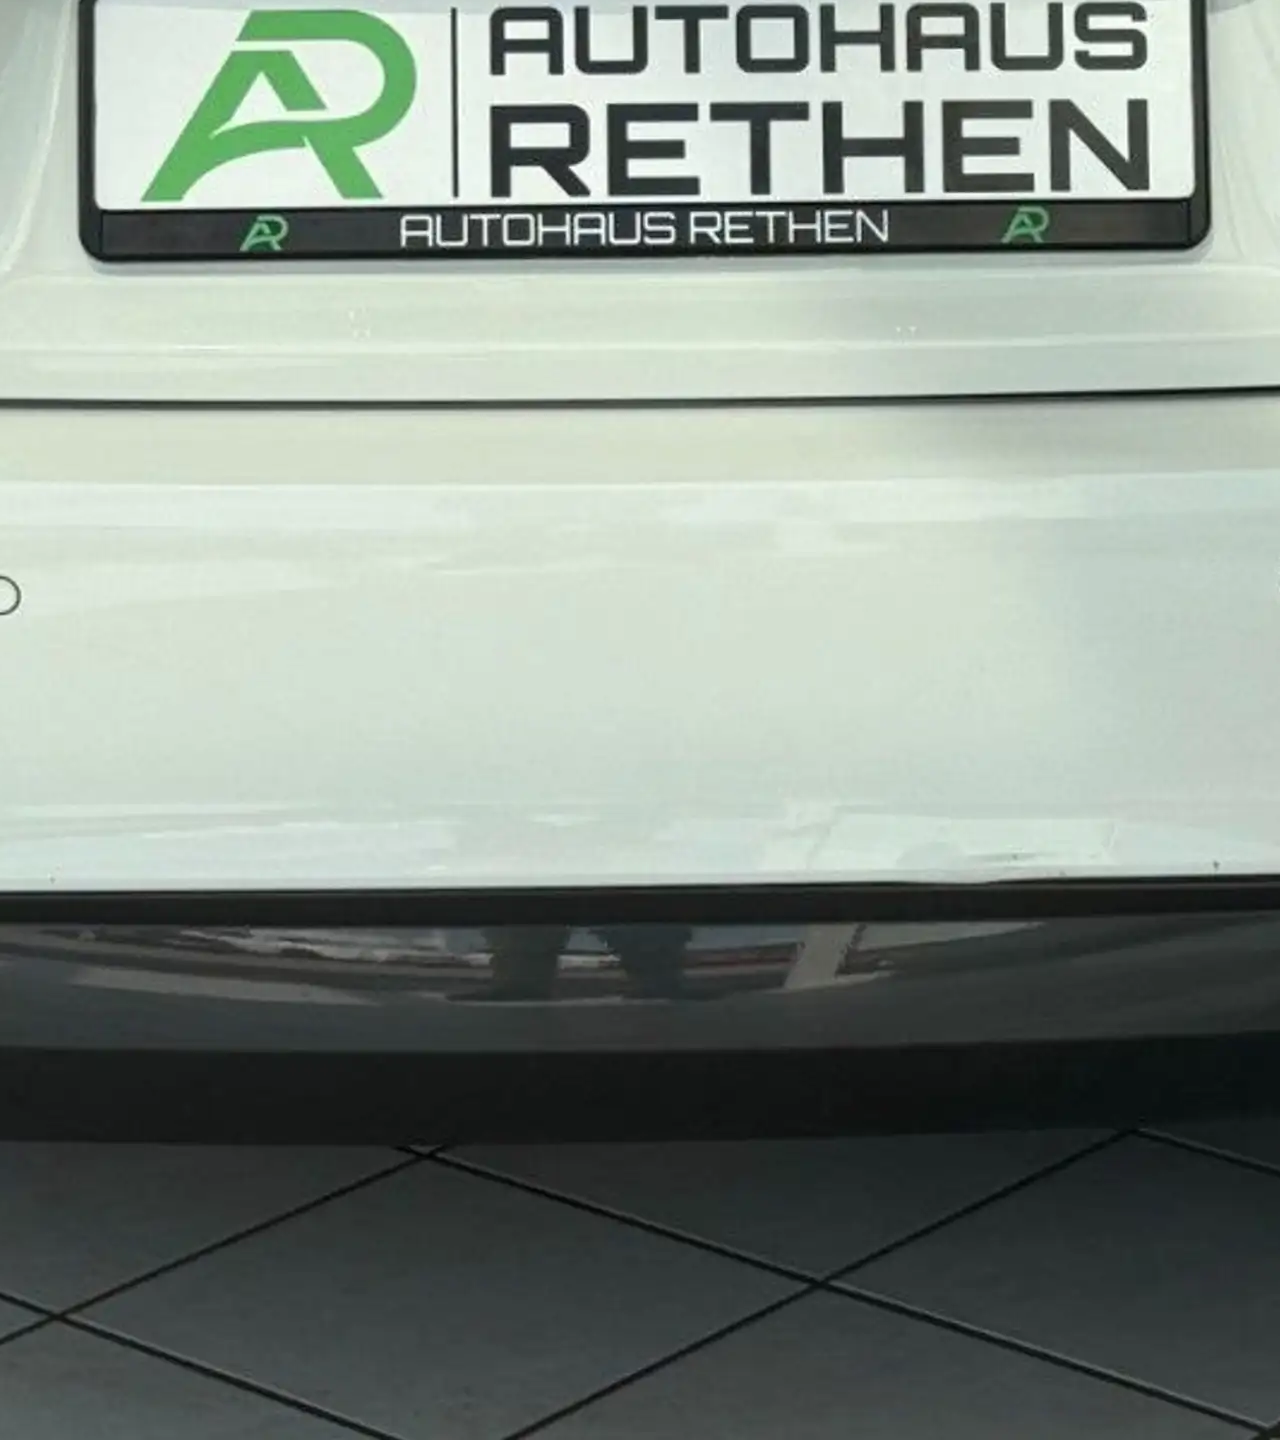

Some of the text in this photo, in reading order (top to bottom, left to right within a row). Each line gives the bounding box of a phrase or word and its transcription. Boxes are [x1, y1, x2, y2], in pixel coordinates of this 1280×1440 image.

[490, 2, 1147, 76] AUTOHAUS
[490, 98, 1150, 198] RETHEN
[399, 209, 888, 248] AUTOHAUS RETHEN
